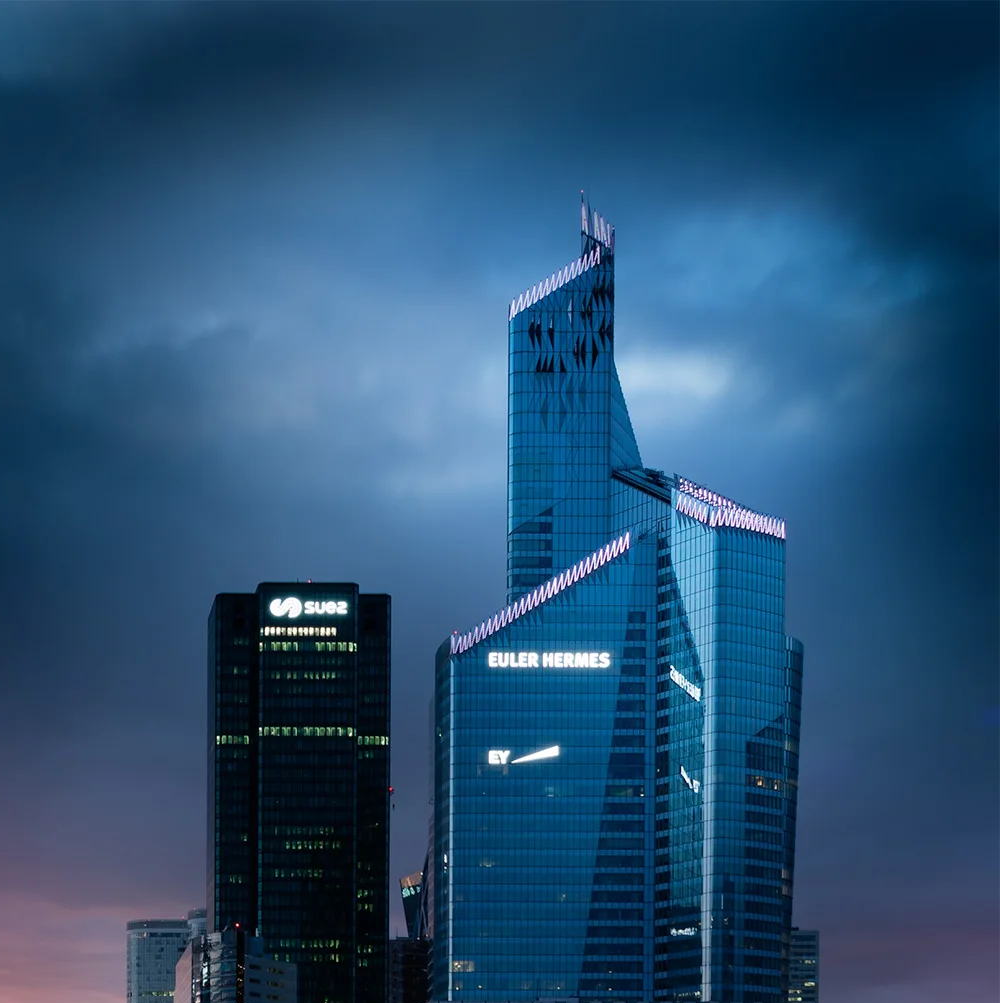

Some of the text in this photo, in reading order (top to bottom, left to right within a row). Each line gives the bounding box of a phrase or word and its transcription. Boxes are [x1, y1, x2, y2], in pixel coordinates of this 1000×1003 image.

[488, 652, 611, 668] EULER HERMES
[488, 750, 511, 764] EY
